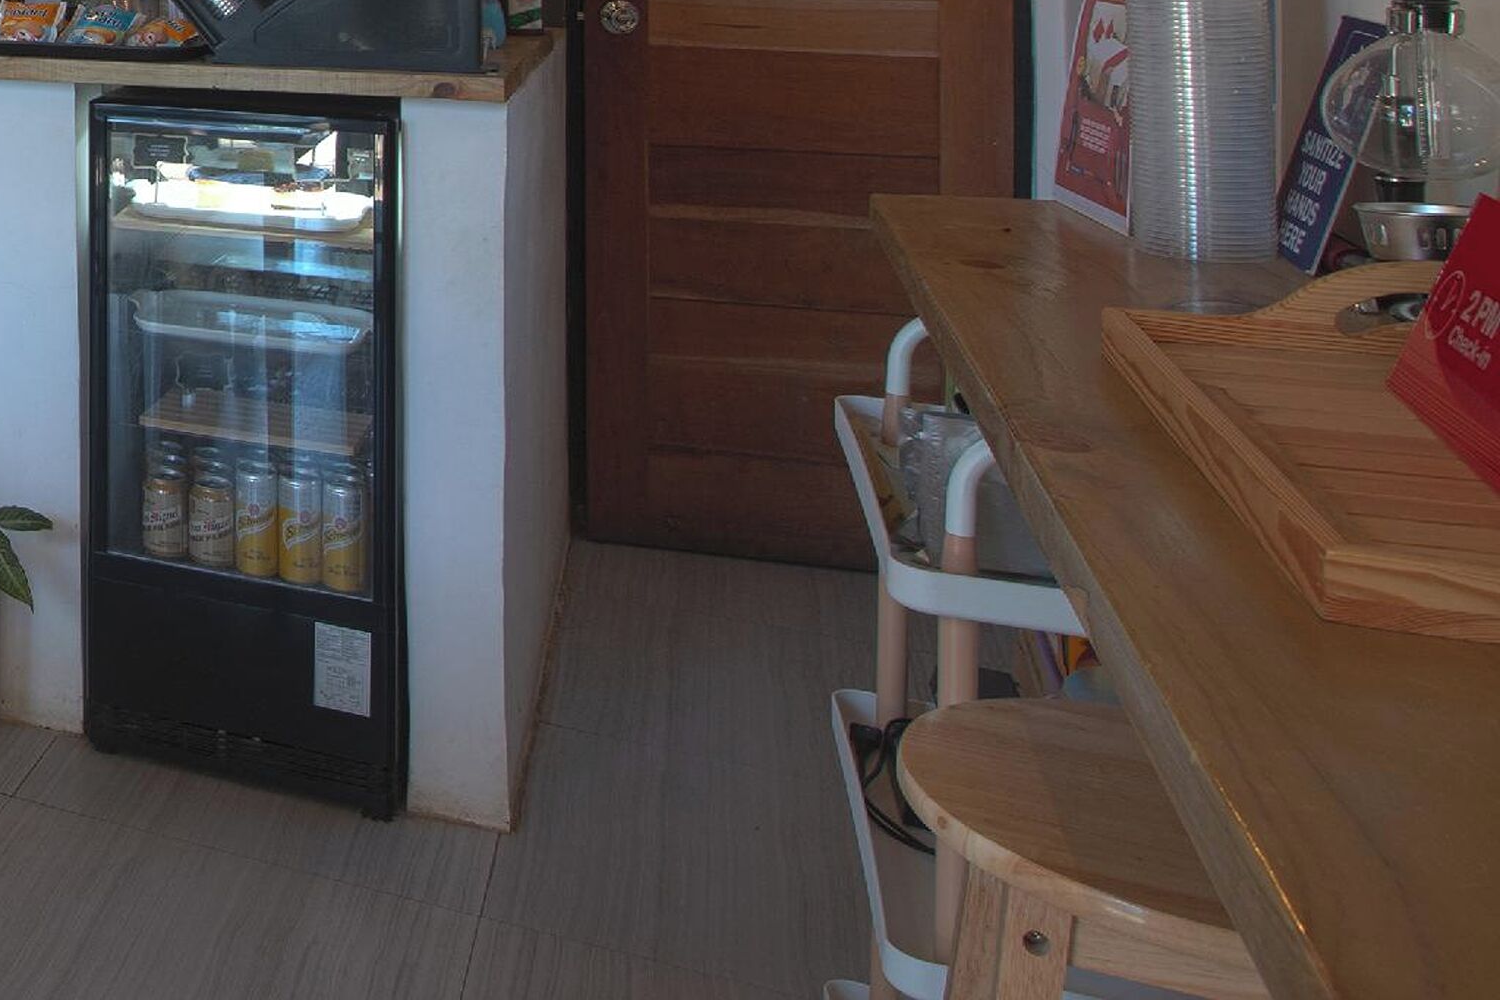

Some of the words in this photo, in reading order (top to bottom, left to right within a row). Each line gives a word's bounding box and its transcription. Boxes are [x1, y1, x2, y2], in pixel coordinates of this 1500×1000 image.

[1302, 130, 1345, 170] SANITIZE
[1298, 162, 1327, 196] YOUR
[1284, 188, 1320, 226] HANDS
[1447, 324, 1492, 371] Check-in
